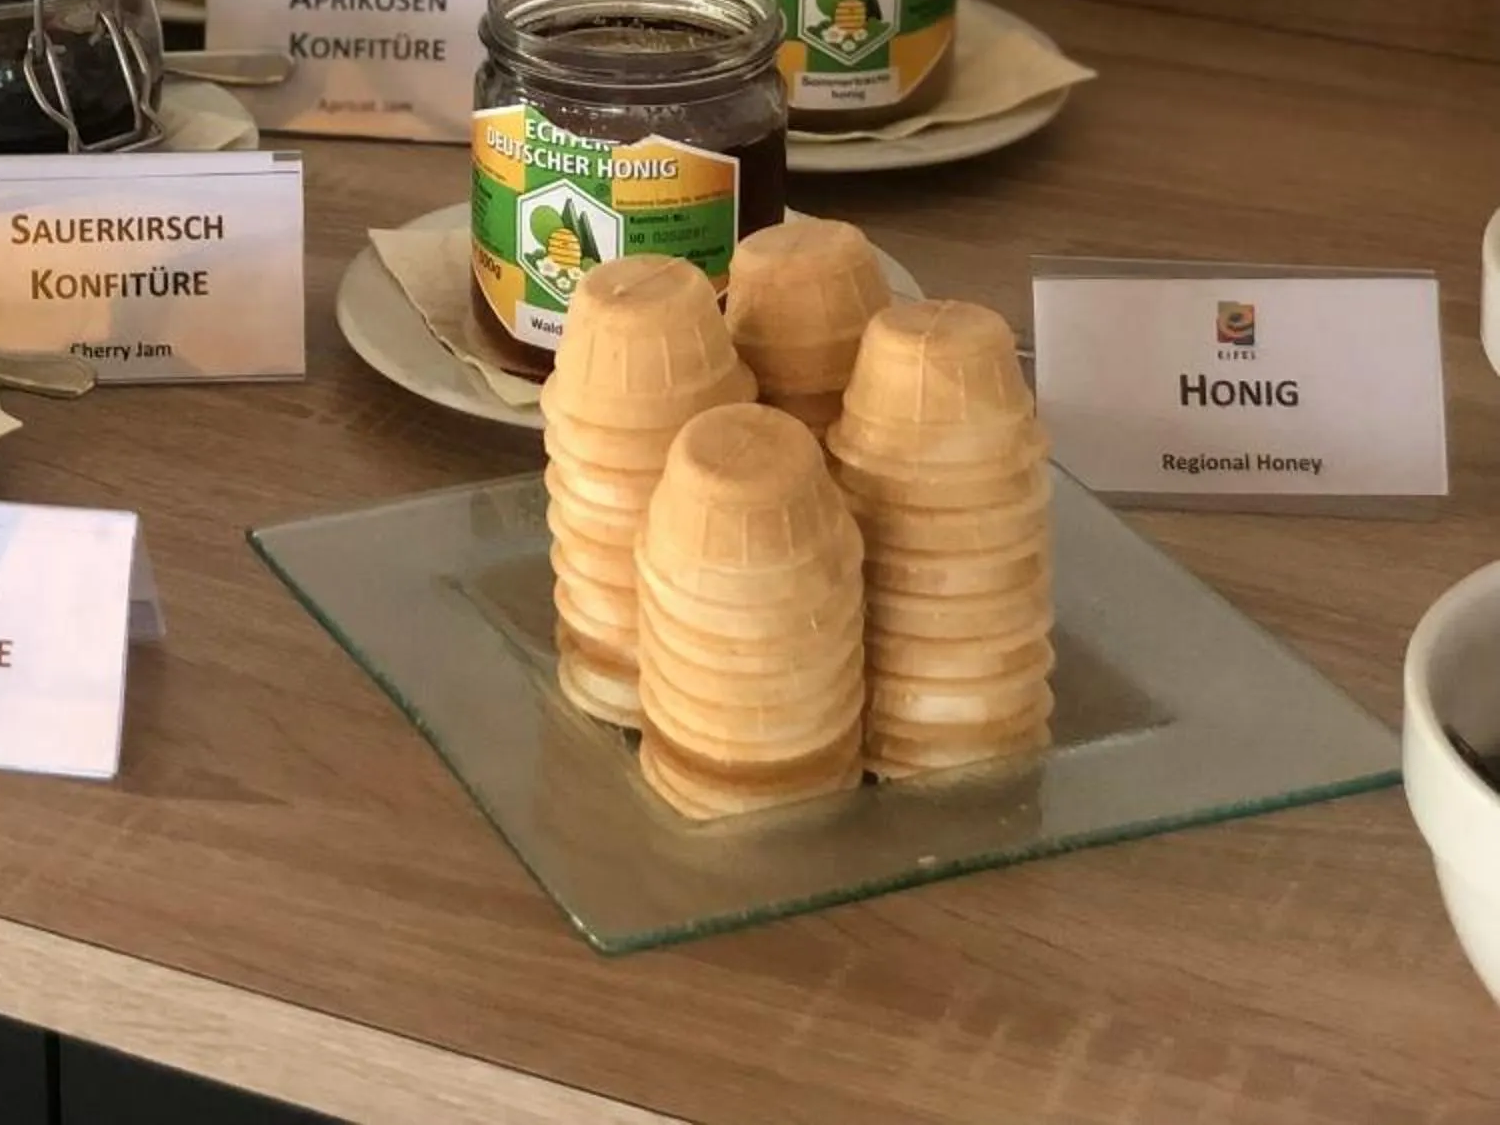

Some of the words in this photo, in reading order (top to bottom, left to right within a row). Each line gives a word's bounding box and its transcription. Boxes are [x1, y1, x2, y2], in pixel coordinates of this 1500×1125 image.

[289, 32, 446, 61] KONFITÜRE
[486, 126, 589, 176] DEUTSCHER
[597, 157, 678, 179] HONIG
[11, 213, 225, 245] SAUERKIRSCH
[31, 266, 209, 300] KONFITÜRE
[136, 341, 172, 358] Jam
[1179, 374, 1300, 408] HONIG
[1162, 453, 1250, 475] Regional
[1257, 454, 1323, 476] Honey
